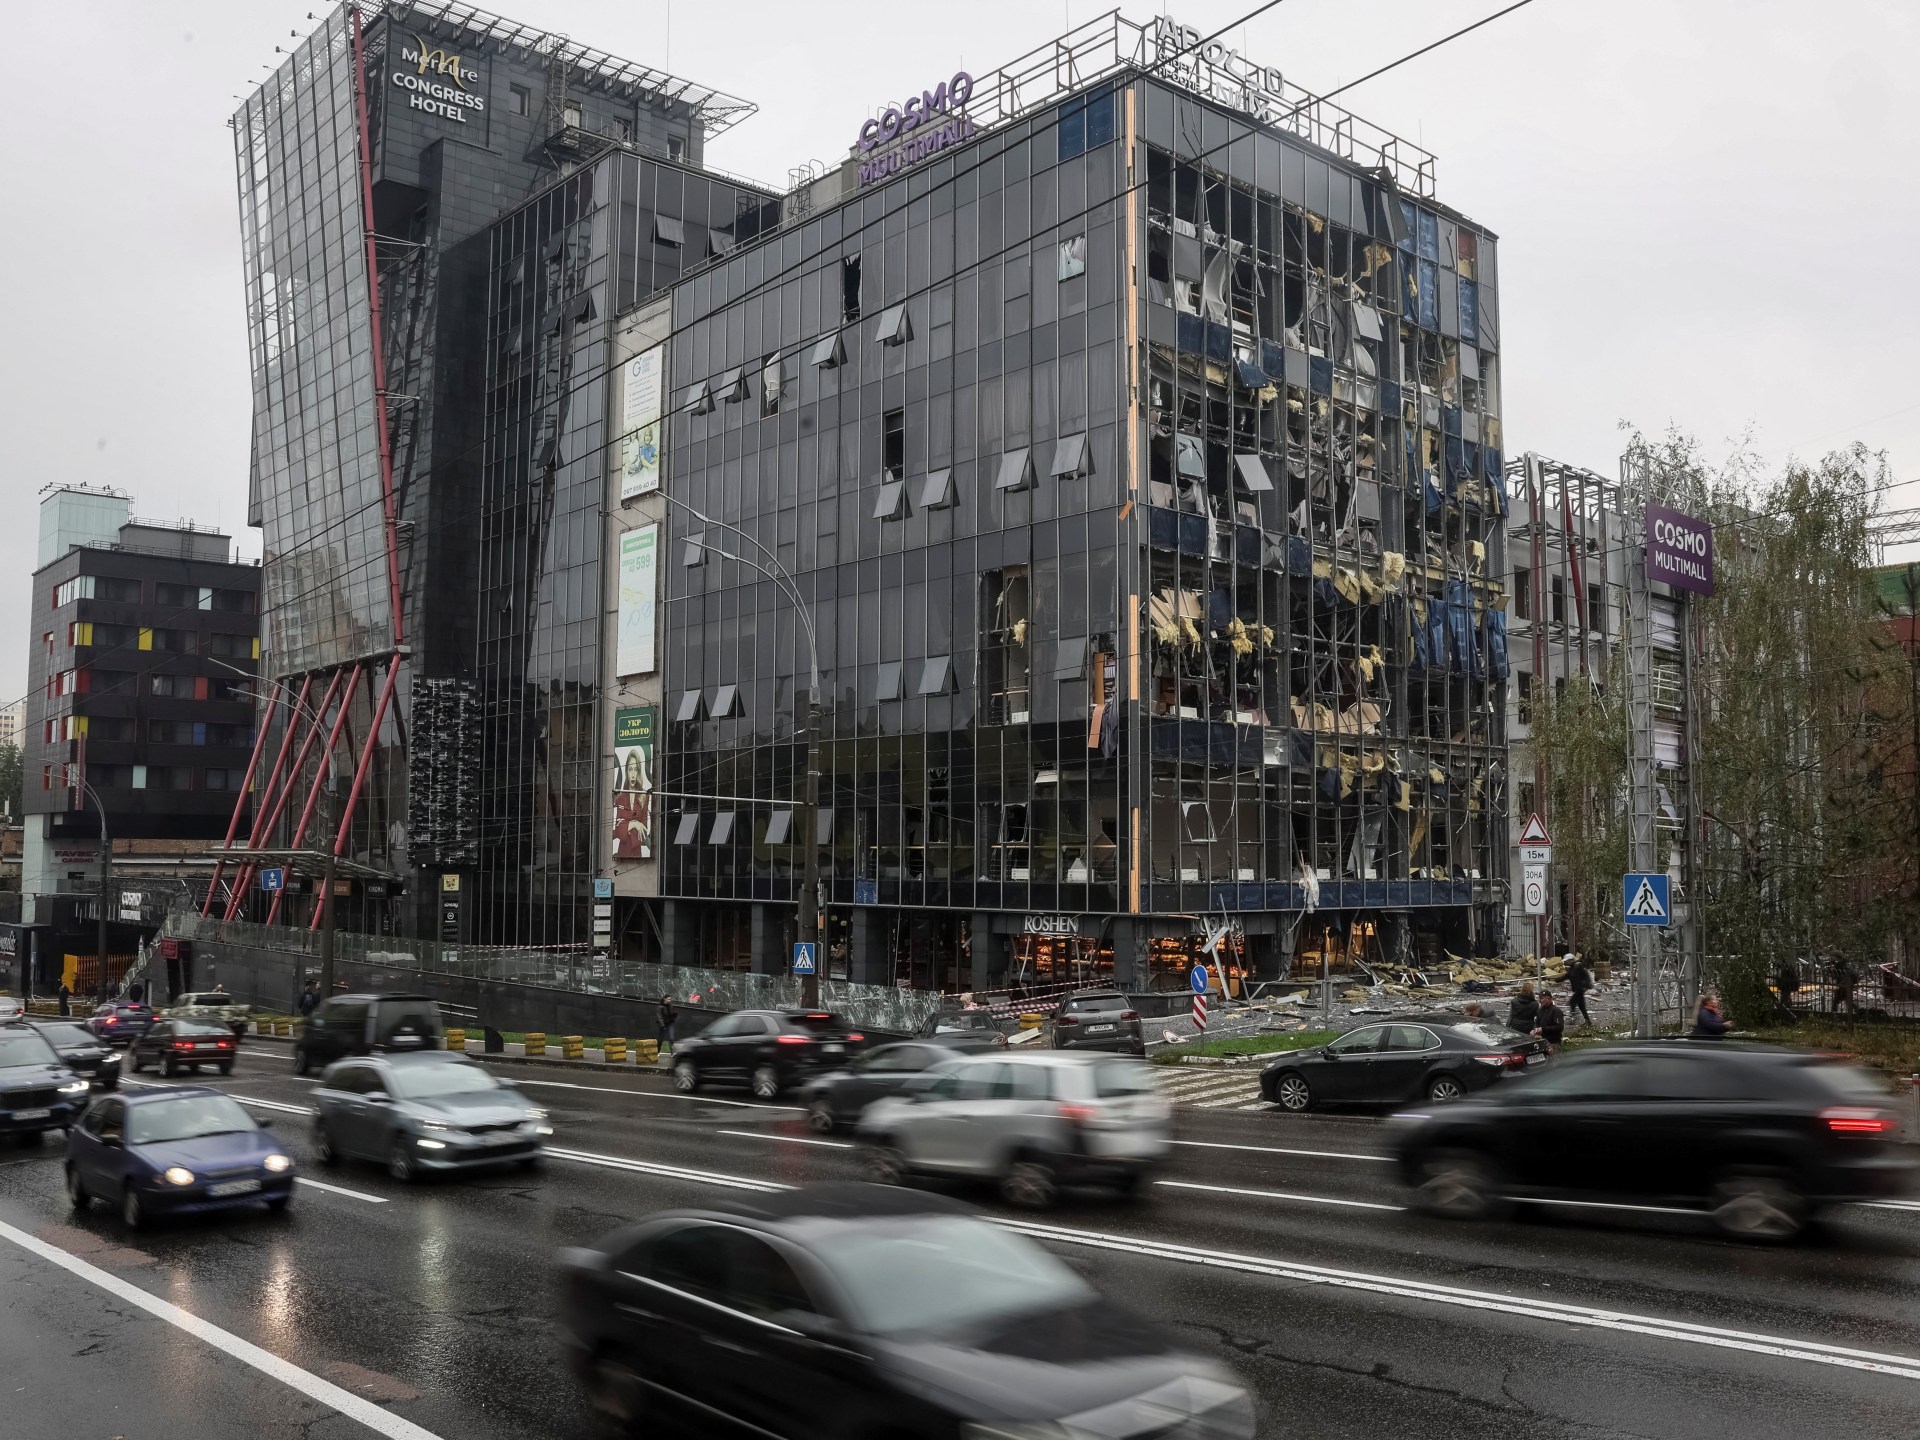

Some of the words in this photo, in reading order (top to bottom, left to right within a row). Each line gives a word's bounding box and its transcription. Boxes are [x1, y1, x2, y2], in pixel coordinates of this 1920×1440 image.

[402, 47, 478, 83] Mercure
[392, 72, 484, 111] CONGRESS
[410, 94, 467, 123] HOTEL
[858, 71, 974, 151] COSMO
[857, 114, 976, 188] MULTIMALL
[1654, 519, 1707, 557] COSMO
[636, 554, 651, 570] 599
[1655, 550, 1707, 581] MULTIMALL
[619, 728, 649, 736] ЗОЛОТО
[627, 719, 641, 727] УКР
[1526, 870, 1542, 879] ЗОНА
[1530, 890, 1538, 900] 10
[1024, 915, 1079, 933] ROSHEN
